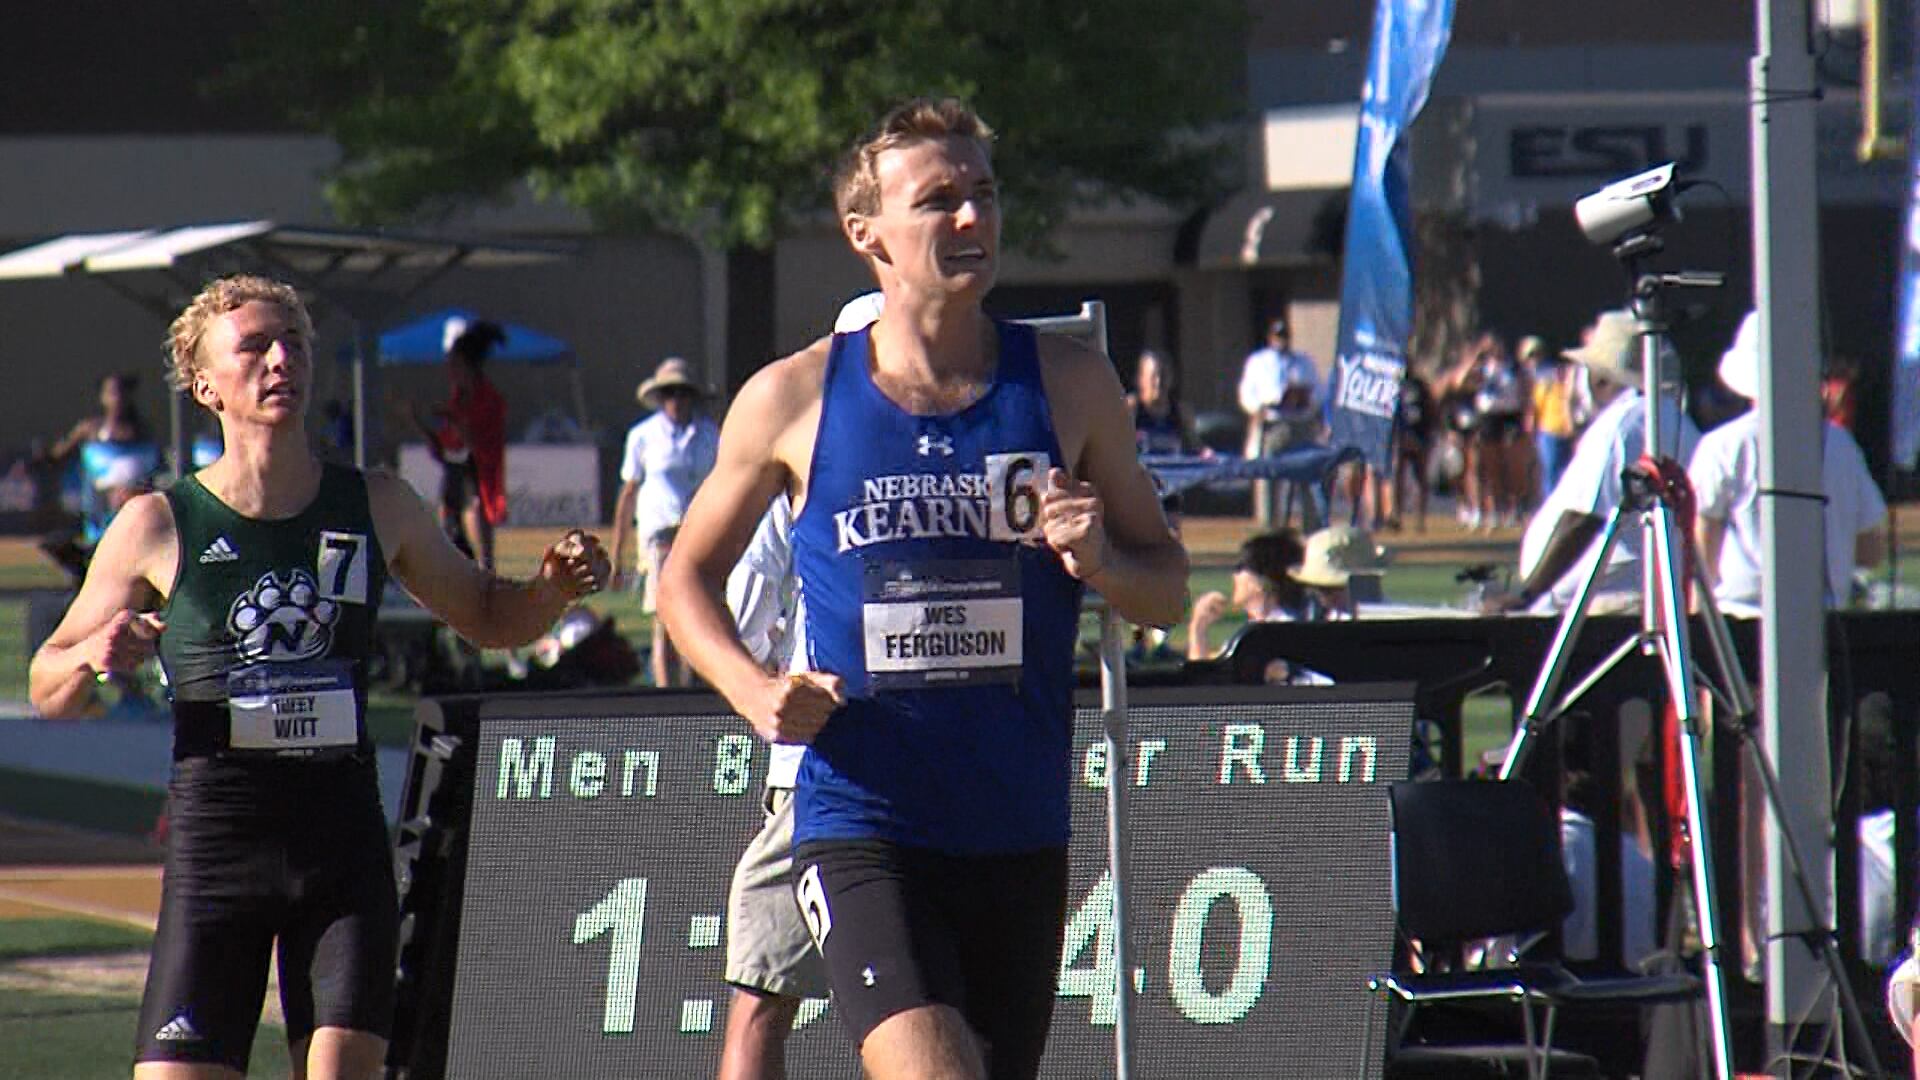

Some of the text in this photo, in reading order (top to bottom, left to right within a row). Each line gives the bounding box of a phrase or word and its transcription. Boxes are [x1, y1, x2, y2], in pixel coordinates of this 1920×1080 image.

[1510, 126, 1708, 176] ESU
[863, 473, 990, 502] NEBRASK
[1004, 457, 1040, 534] 6
[834, 498, 990, 553] KEARN
[326, 538, 359, 596] 7
[923, 605, 967, 625] WES
[885, 630, 1006, 659] FERGUSON
[274, 716, 321, 738] WITT
[497, 735, 661, 799] Men
[1218, 724, 1378, 785] Run
